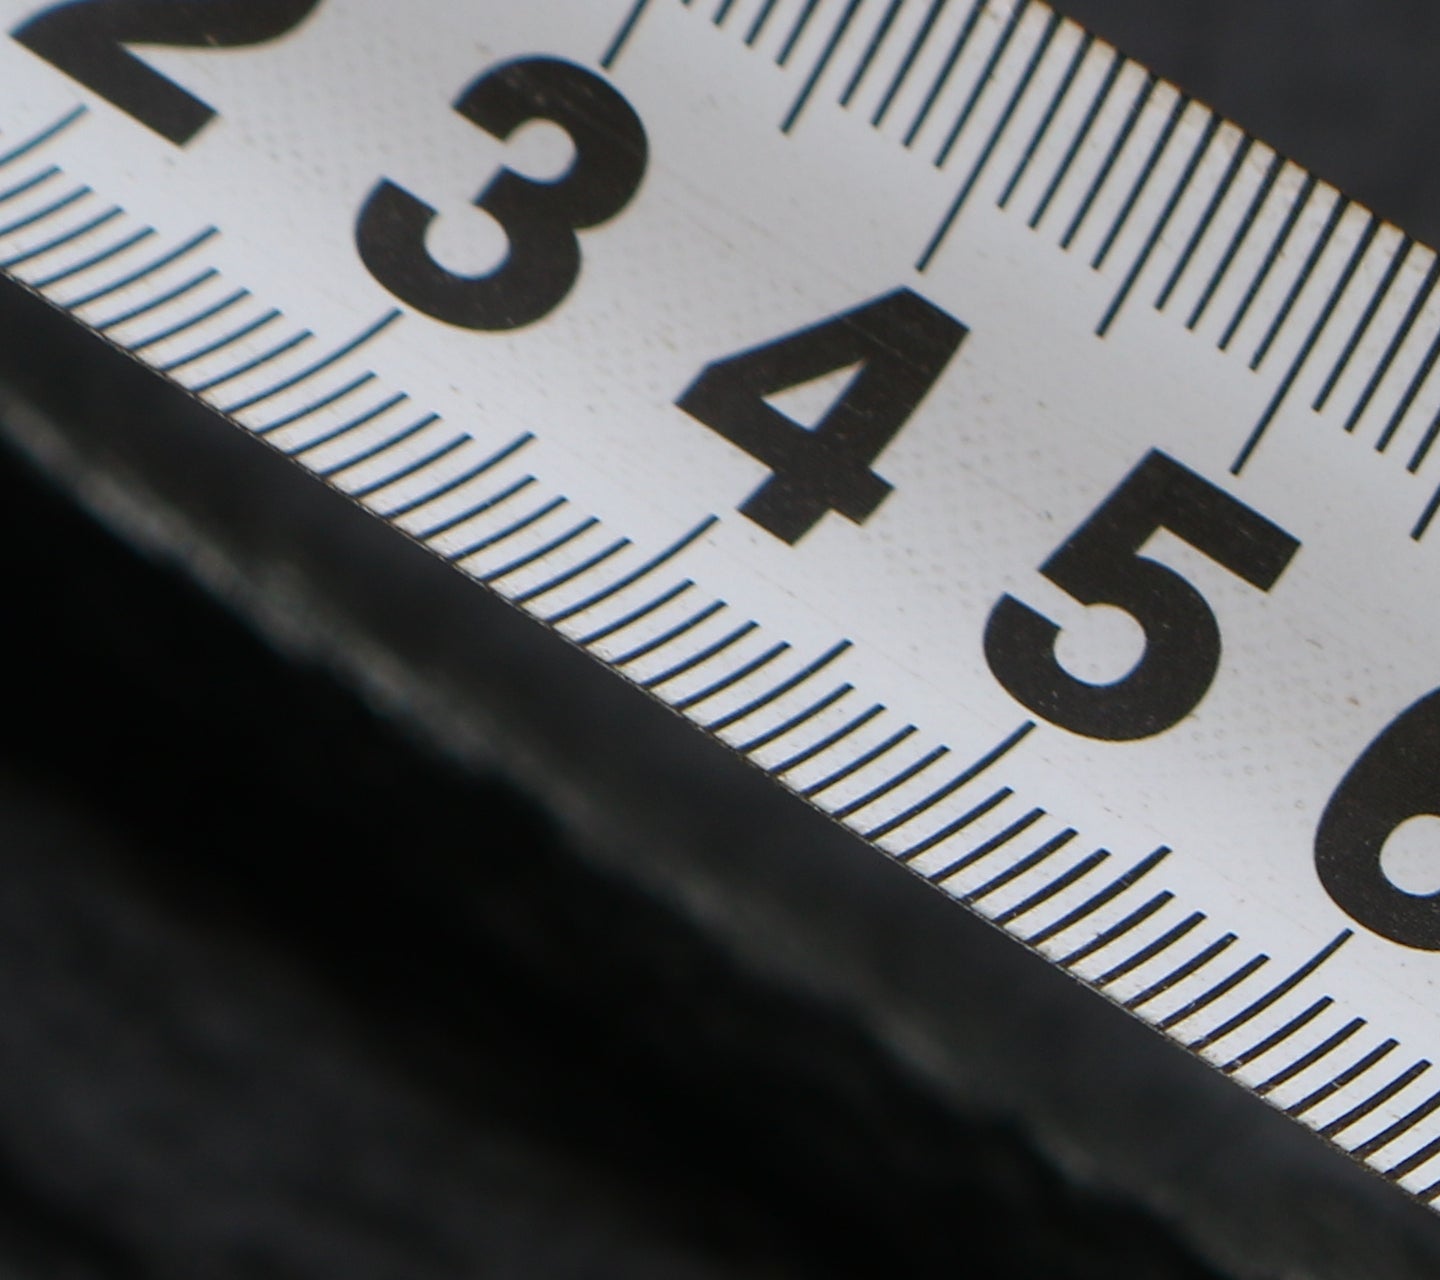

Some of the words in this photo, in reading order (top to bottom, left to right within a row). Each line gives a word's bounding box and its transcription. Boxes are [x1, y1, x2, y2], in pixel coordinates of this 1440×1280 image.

[354, 54, 650, 332] 3
[674, 286, 970, 546] 4
[982, 448, 1302, 743] 5
